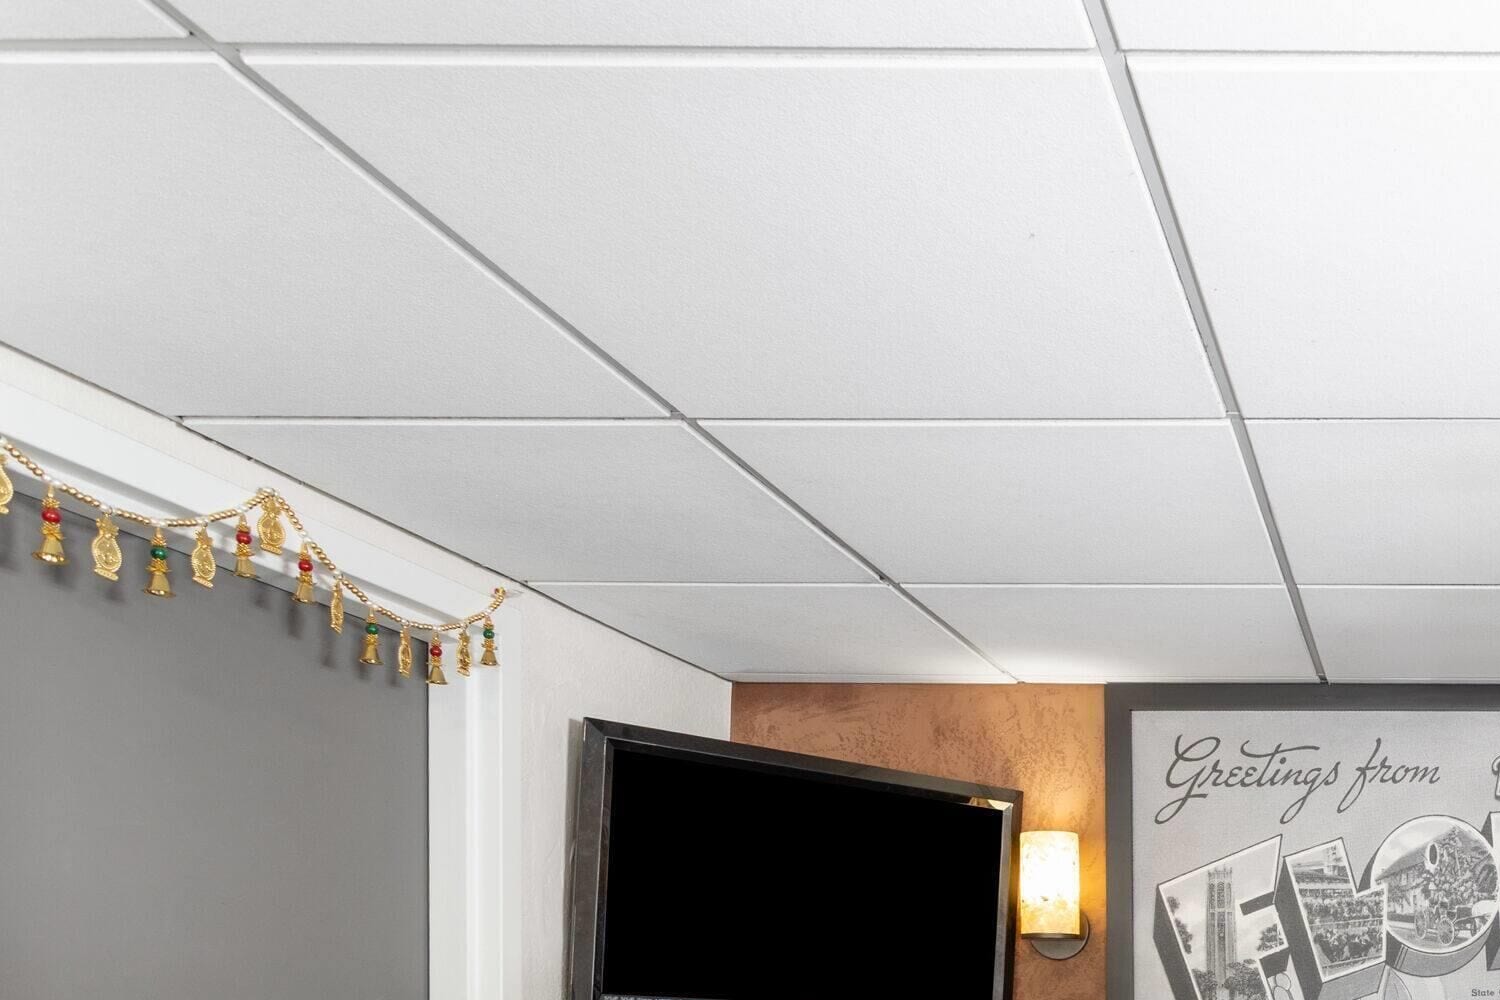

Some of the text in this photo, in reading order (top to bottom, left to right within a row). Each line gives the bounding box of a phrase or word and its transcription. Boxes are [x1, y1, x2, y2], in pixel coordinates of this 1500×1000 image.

[1154, 733, 1441, 825] Greetings from
[1471, 988, 1495, 997] State
